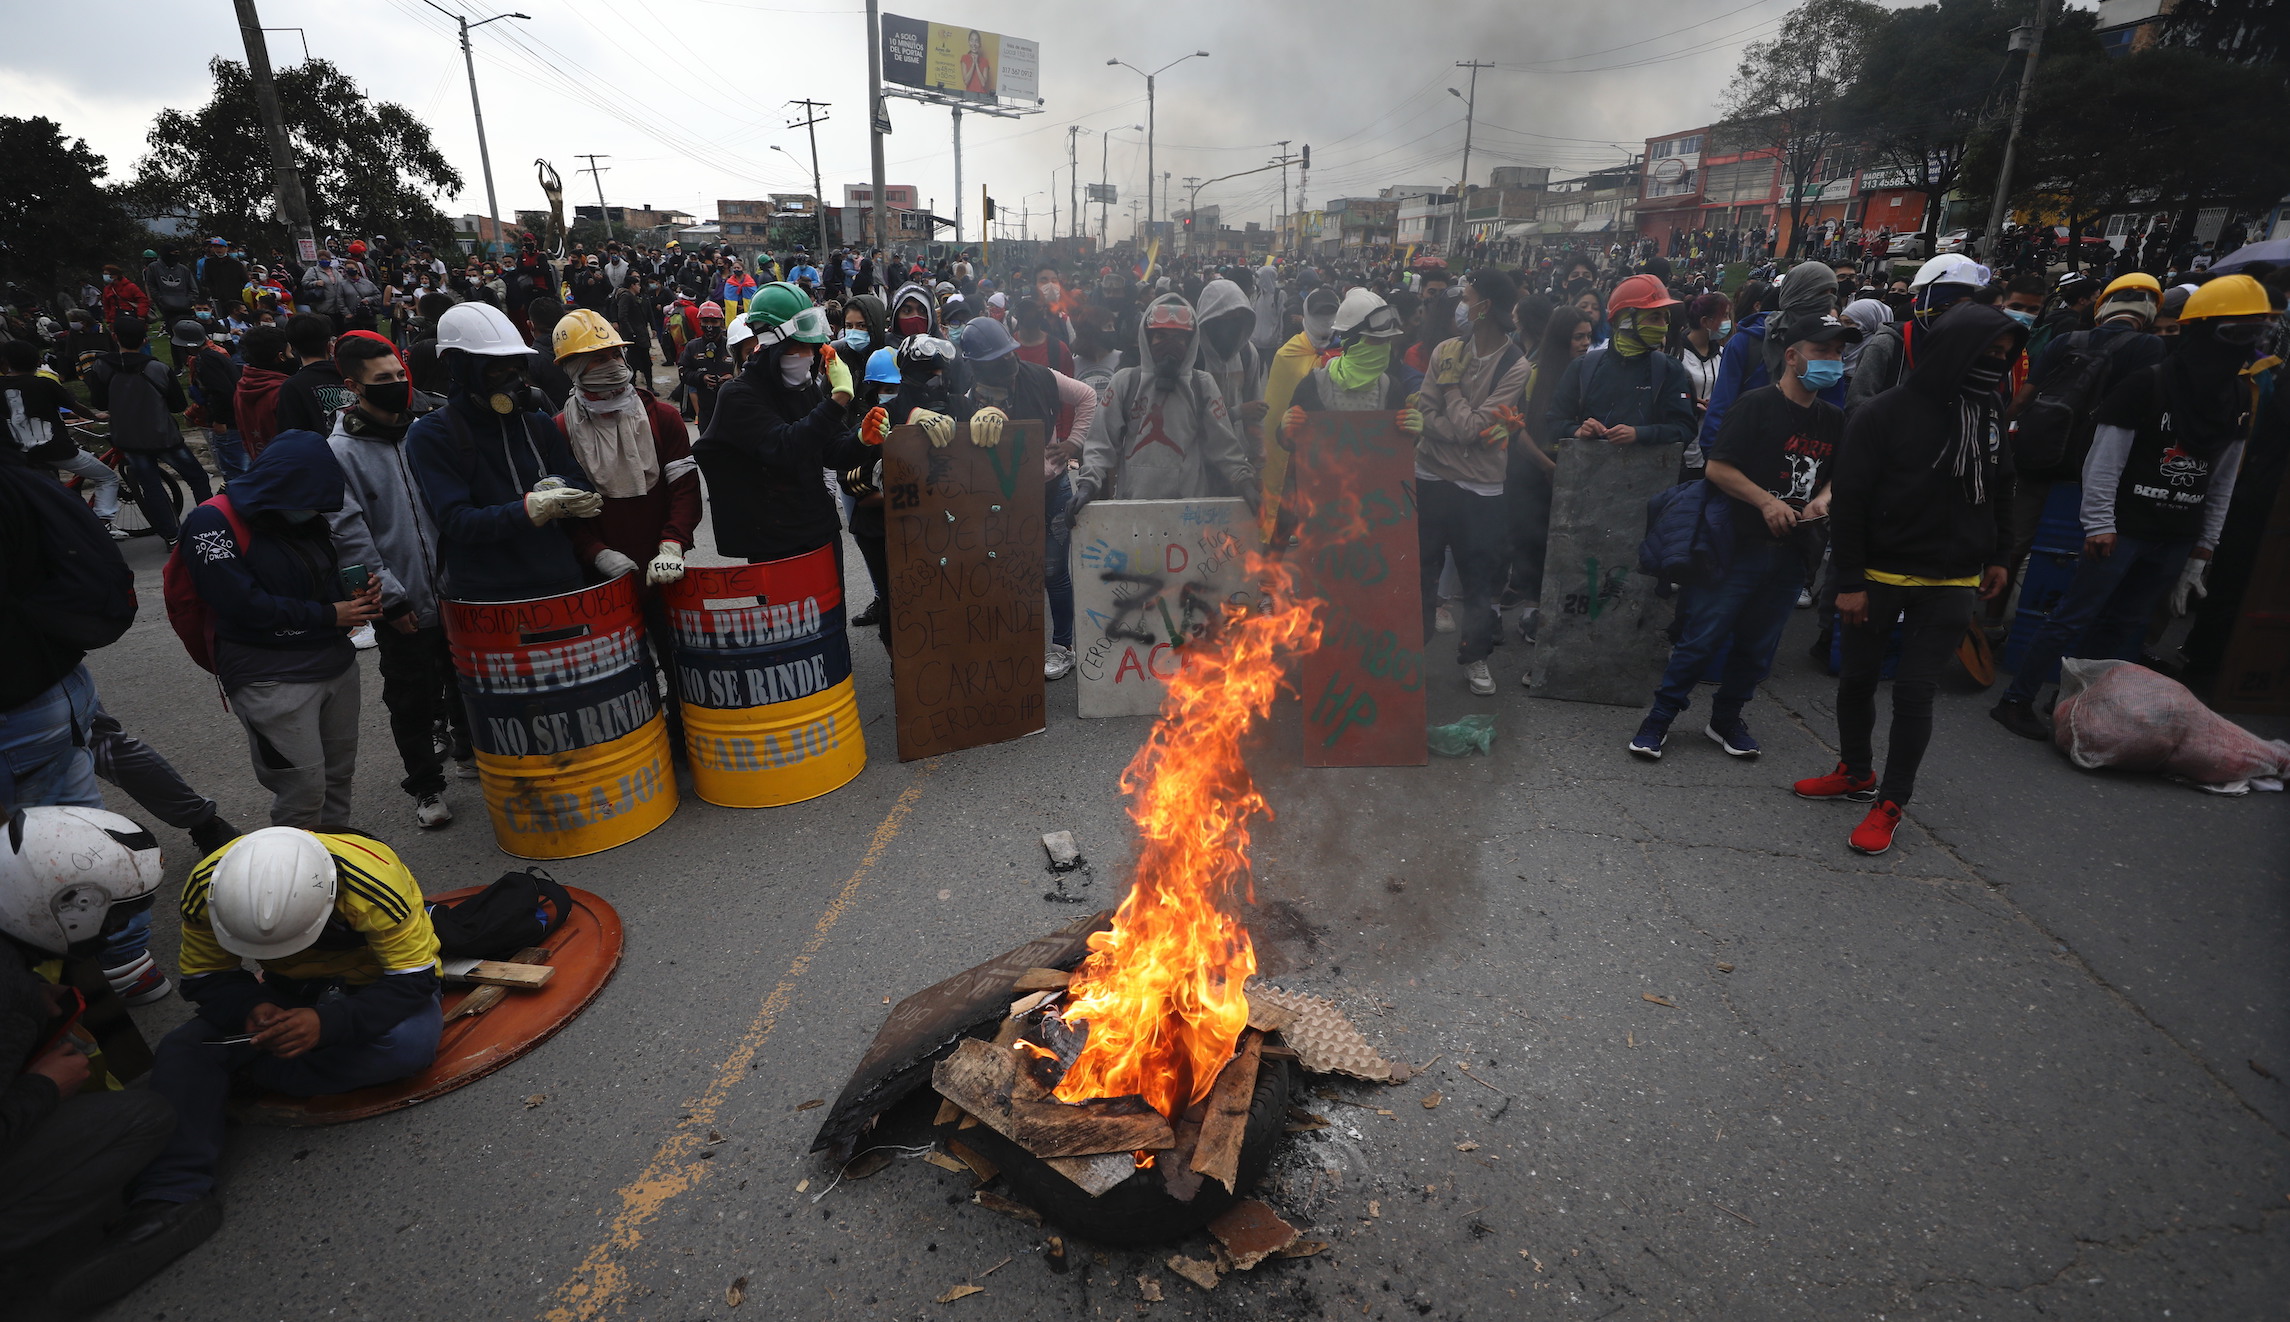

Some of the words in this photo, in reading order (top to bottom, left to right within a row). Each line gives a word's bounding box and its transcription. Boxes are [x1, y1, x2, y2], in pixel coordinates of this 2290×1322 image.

[889, 37, 897, 45] 10
[897, 40, 924, 51] MINUTOS
[890, 46, 901, 54] DEL
[902, 47, 924, 58] PORTAL
[900, 33, 917, 41] SOLO
[904, 55, 919, 64] USME
[1861, 180, 1877, 189] 313
[923, 414, 947, 431] FUCK
[890, 483, 920, 510] 28
[2133, 484, 2170, 501] BEER
[898, 514, 1039, 564] PUEBLO
[1197, 527, 1239, 554] FUCK
[655, 562, 682, 573] FUCK
[939, 561, 992, 601] NO
[1197, 540, 1247, 582] POLICE
[711, 596, 822, 648] PUEBLO
[895, 608, 952, 660] SE
[965, 599, 1043, 645] RINDE
[527, 624, 641, 692] PUEBLO
[678, 664, 707, 706] NO
[708, 669, 743, 708] SE
[745, 653, 829, 705] RINDE
[916, 655, 1035, 707] CARAJO
[487, 715, 529, 757] NO
[532, 710, 575, 756] SE
[575, 680, 655, 744] RINDE
[909, 697, 1016, 747] CERDOS
[693, 715, 841, 773] CARAJO!
[502, 757, 665, 834] CARAJO!
